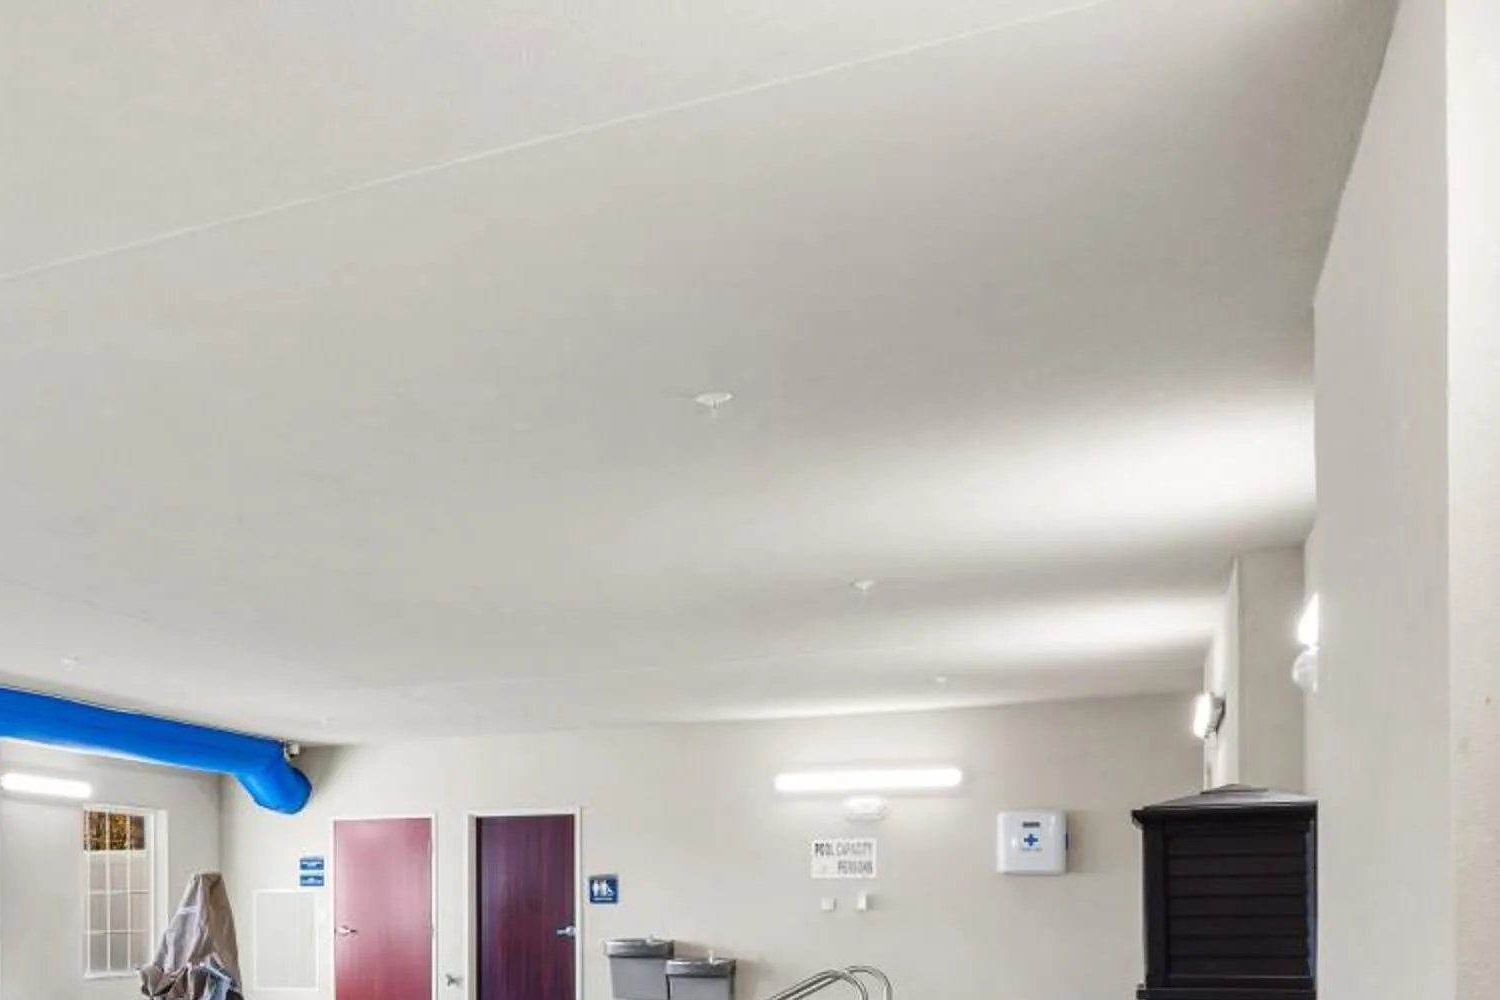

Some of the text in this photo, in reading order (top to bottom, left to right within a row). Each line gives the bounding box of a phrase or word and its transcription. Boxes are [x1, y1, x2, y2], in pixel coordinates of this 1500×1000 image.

[814, 841, 873, 857] POOL CAPACITY
[837, 860, 874, 875] PERSONS
